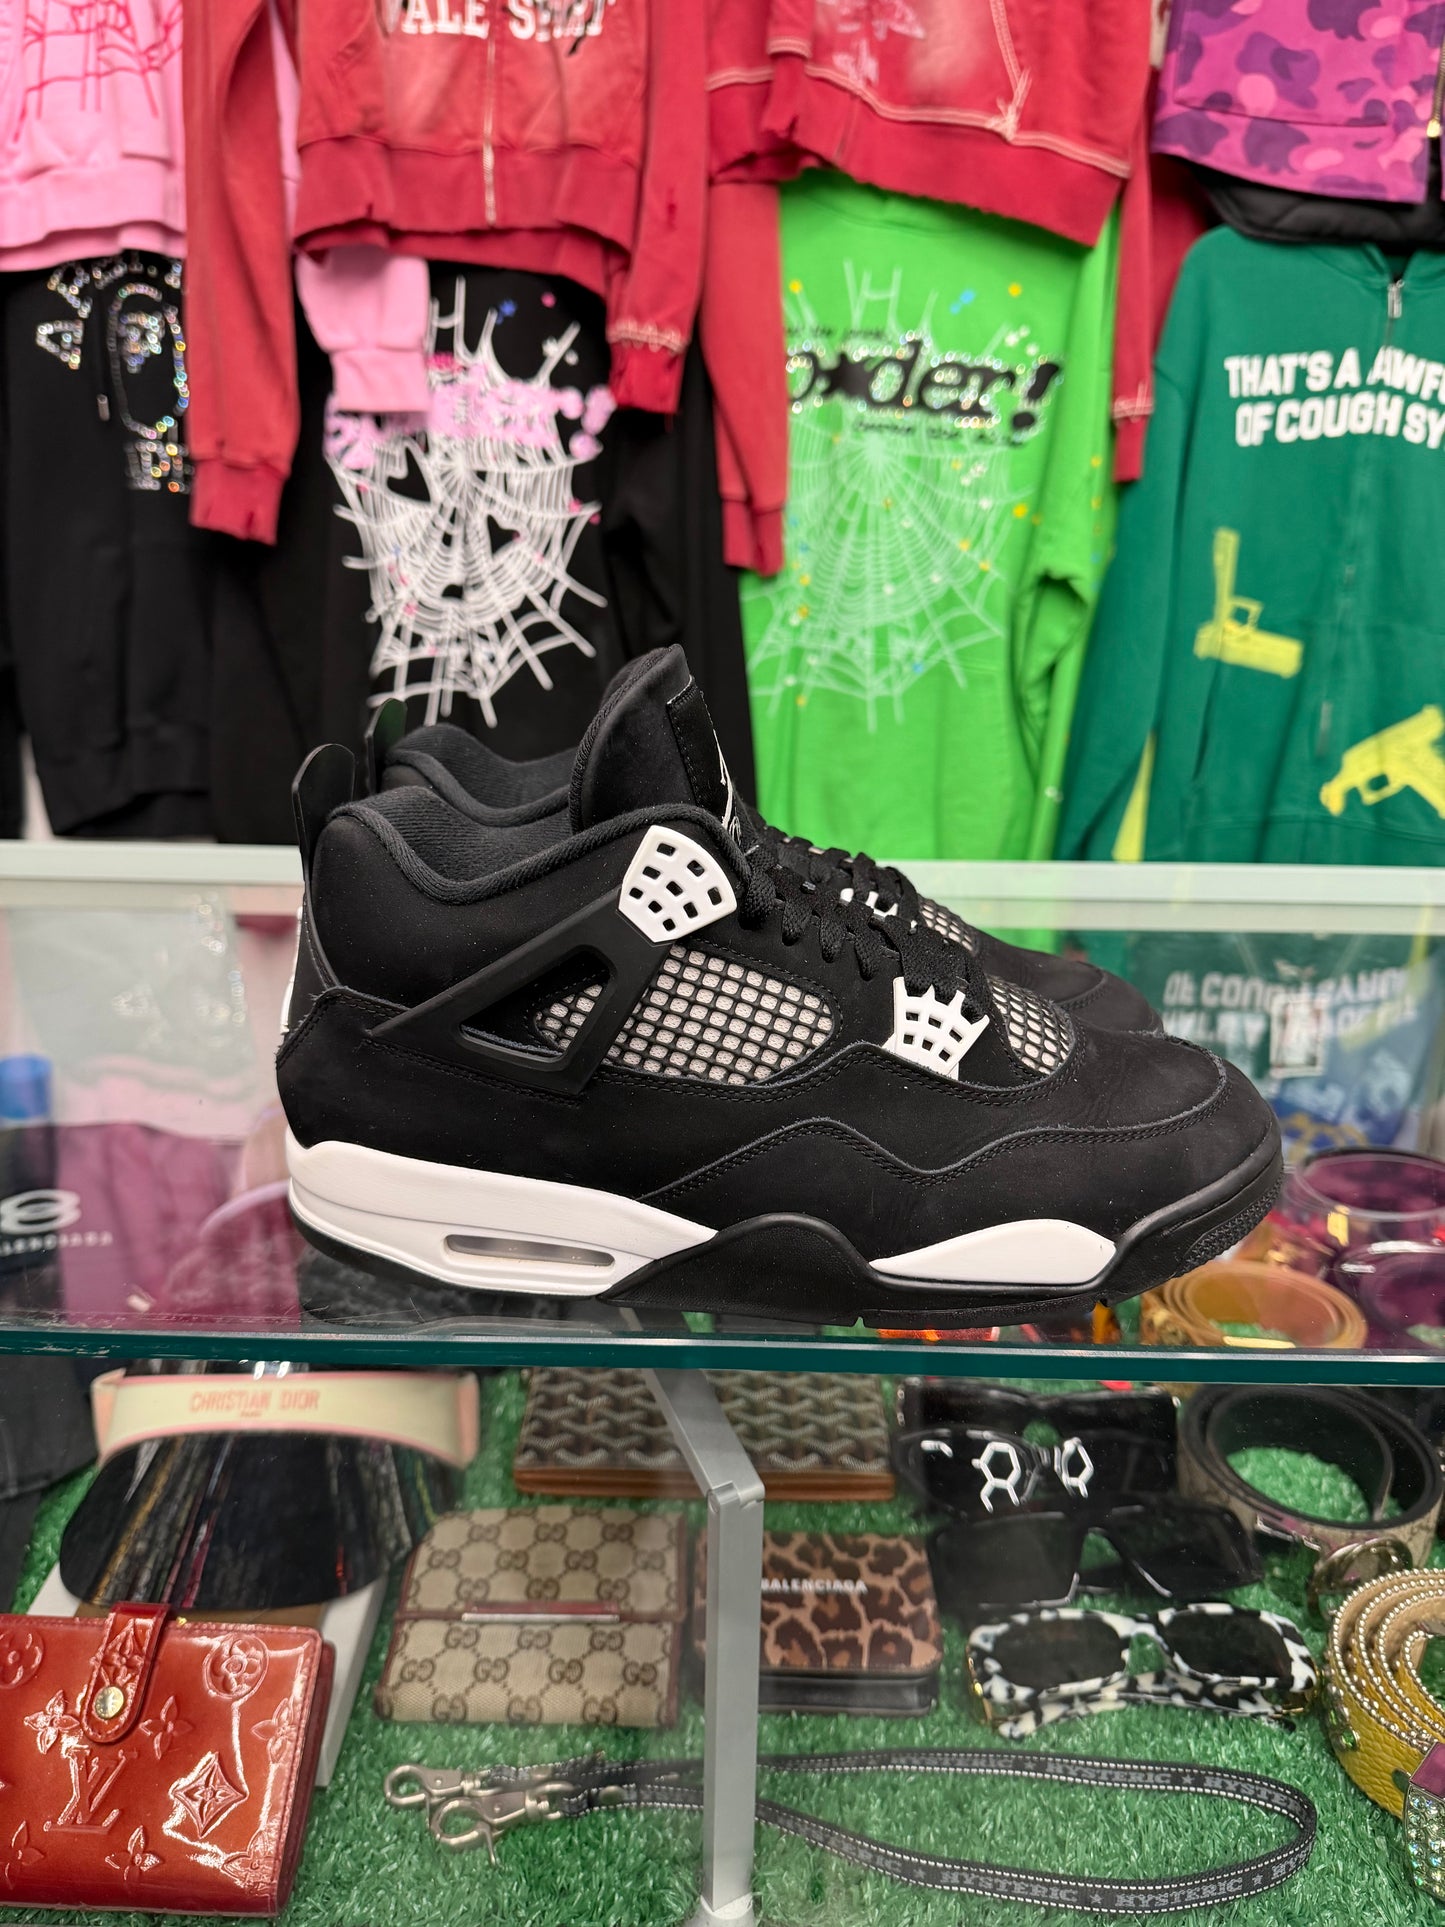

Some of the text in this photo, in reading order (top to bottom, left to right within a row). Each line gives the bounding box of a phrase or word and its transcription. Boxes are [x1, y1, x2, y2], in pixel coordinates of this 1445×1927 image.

[1224, 345, 1445, 404] THAT'S A AWF
[1235, 391, 1445, 450] OF COUGH SY
[190, 1389, 320, 1412] CHRISTIAN DIOR
[1047, 1761, 1172, 1785] HYSTERIC
[940, 1869, 1079, 1903] HYSTERIC
[1115, 1877, 1243, 1908] HYSTERIC
